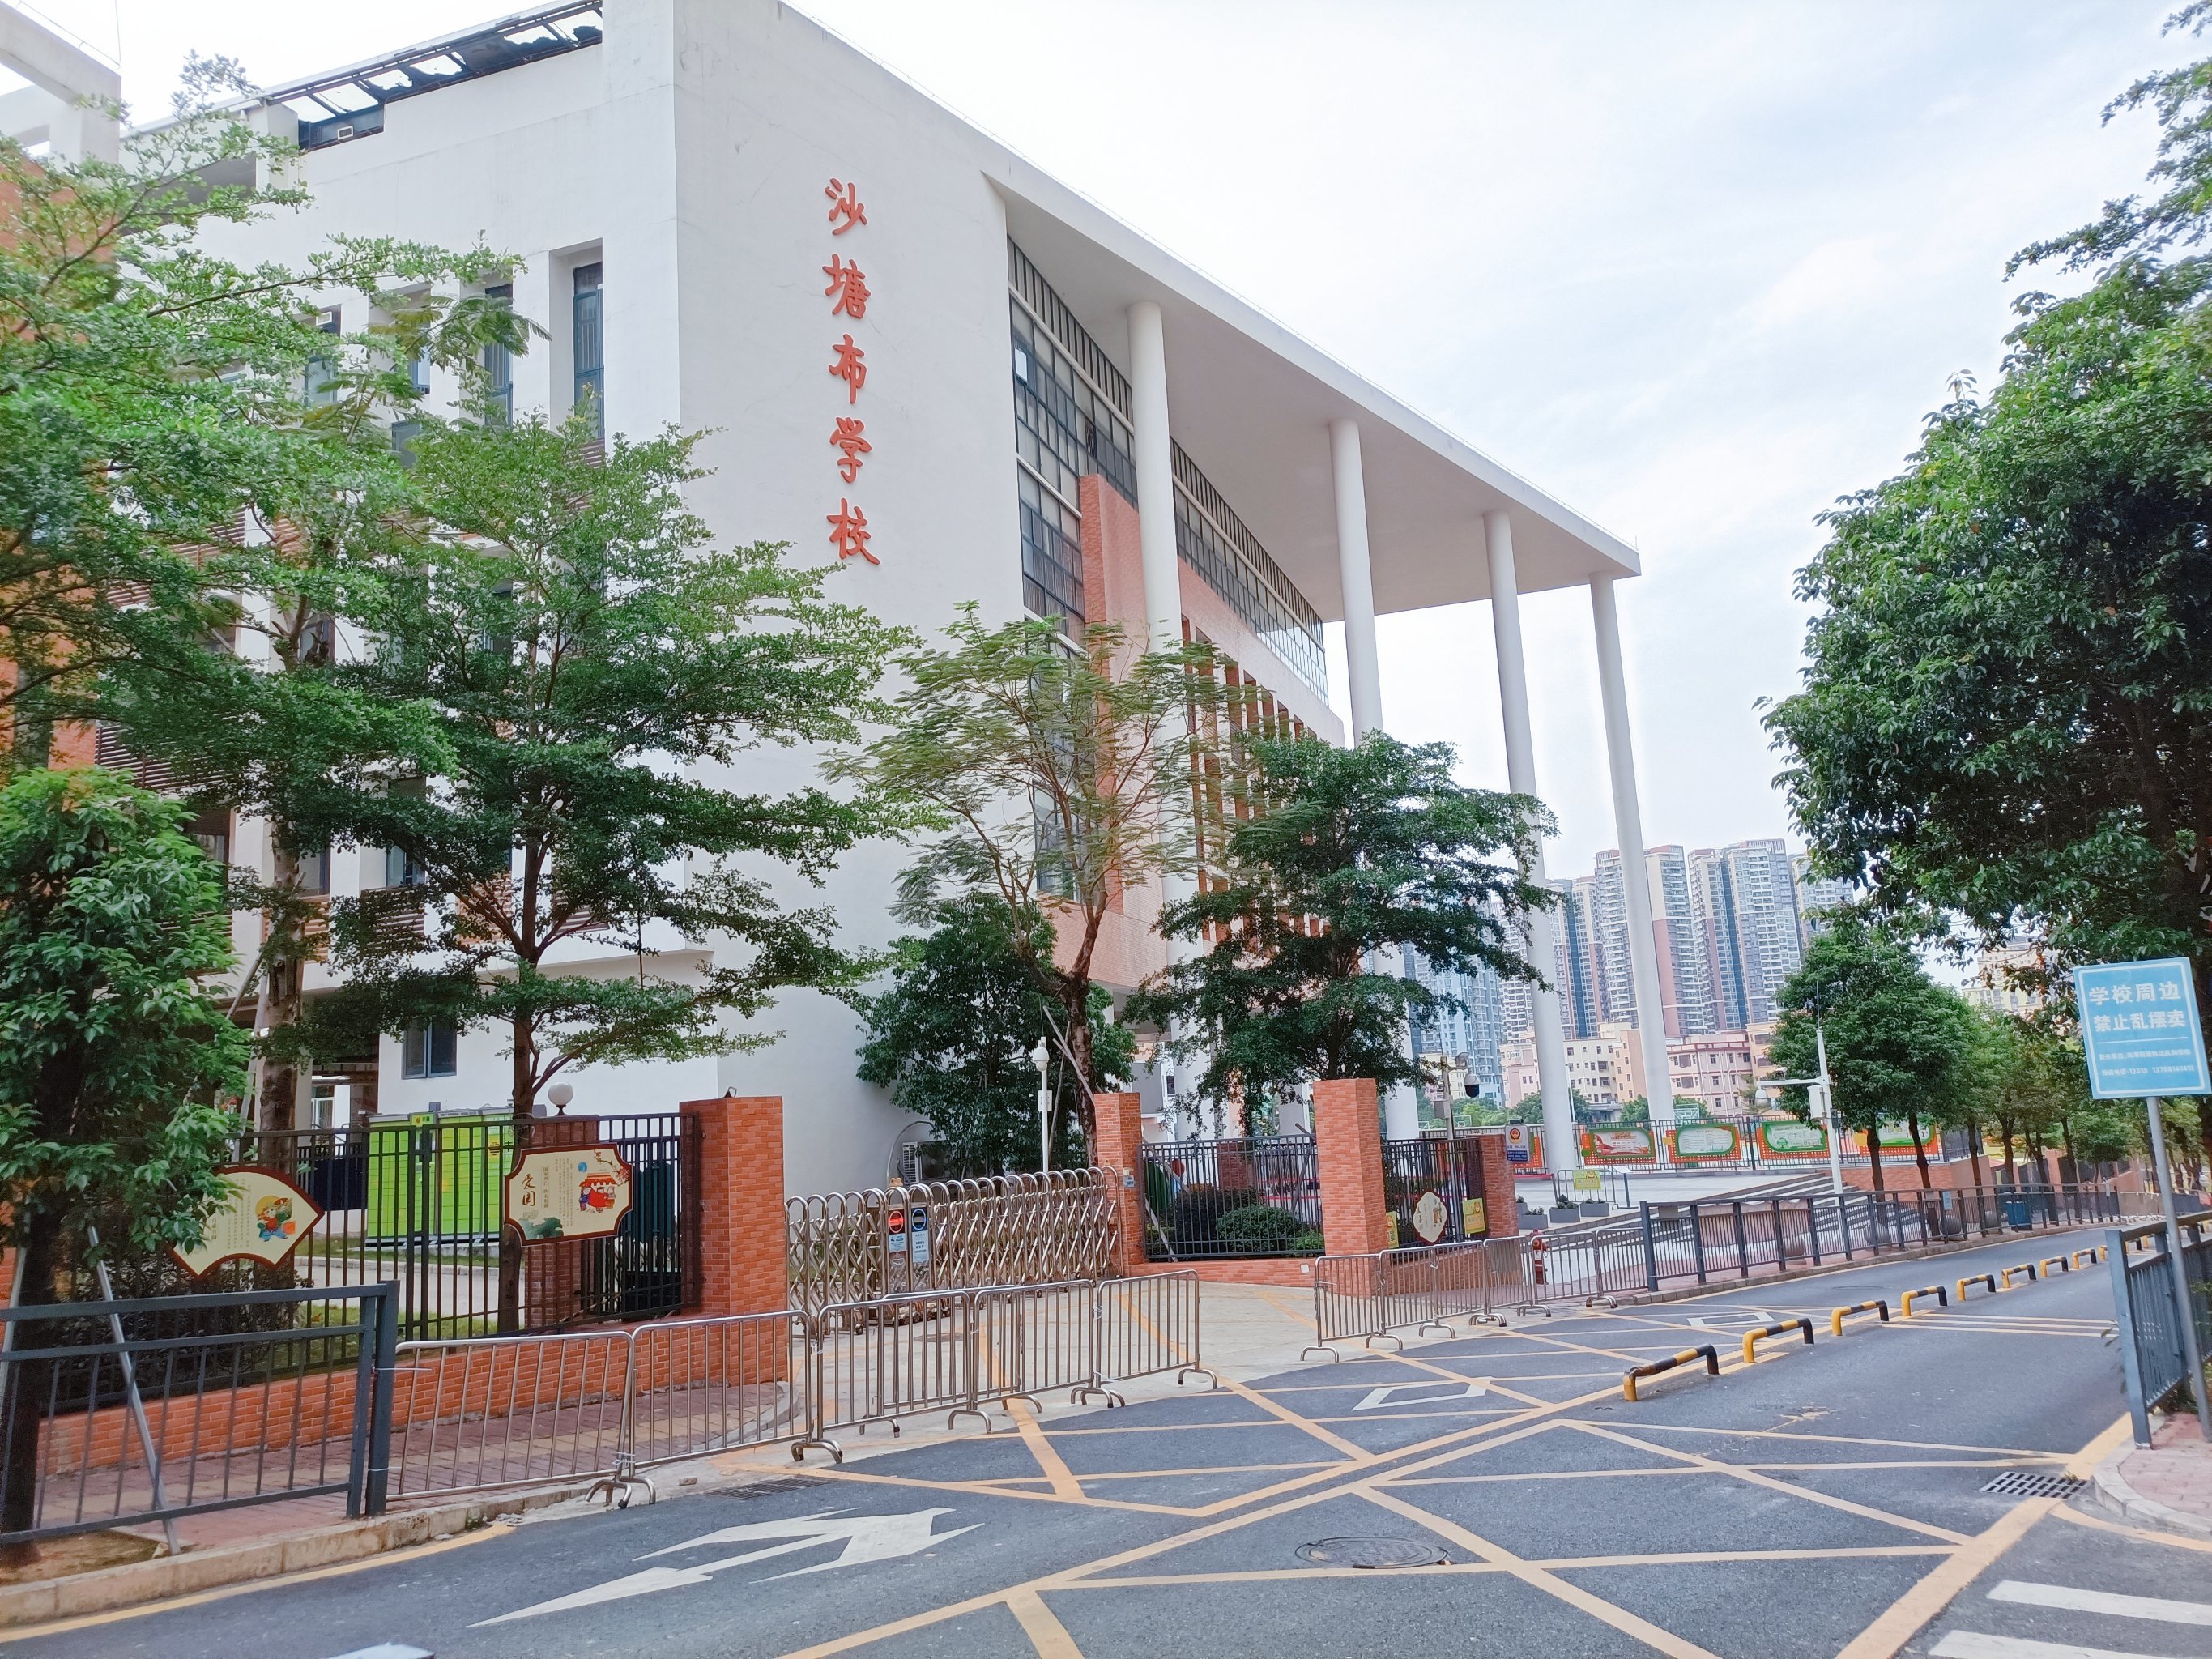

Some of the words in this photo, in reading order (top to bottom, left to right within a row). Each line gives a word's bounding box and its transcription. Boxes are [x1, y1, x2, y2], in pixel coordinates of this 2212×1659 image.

[821, 177, 881, 565] 沙塘布学校
[2088, 981, 2181, 1005] 学校周边
[2094, 1009, 2186, 1032] 禁止乱摆卖
